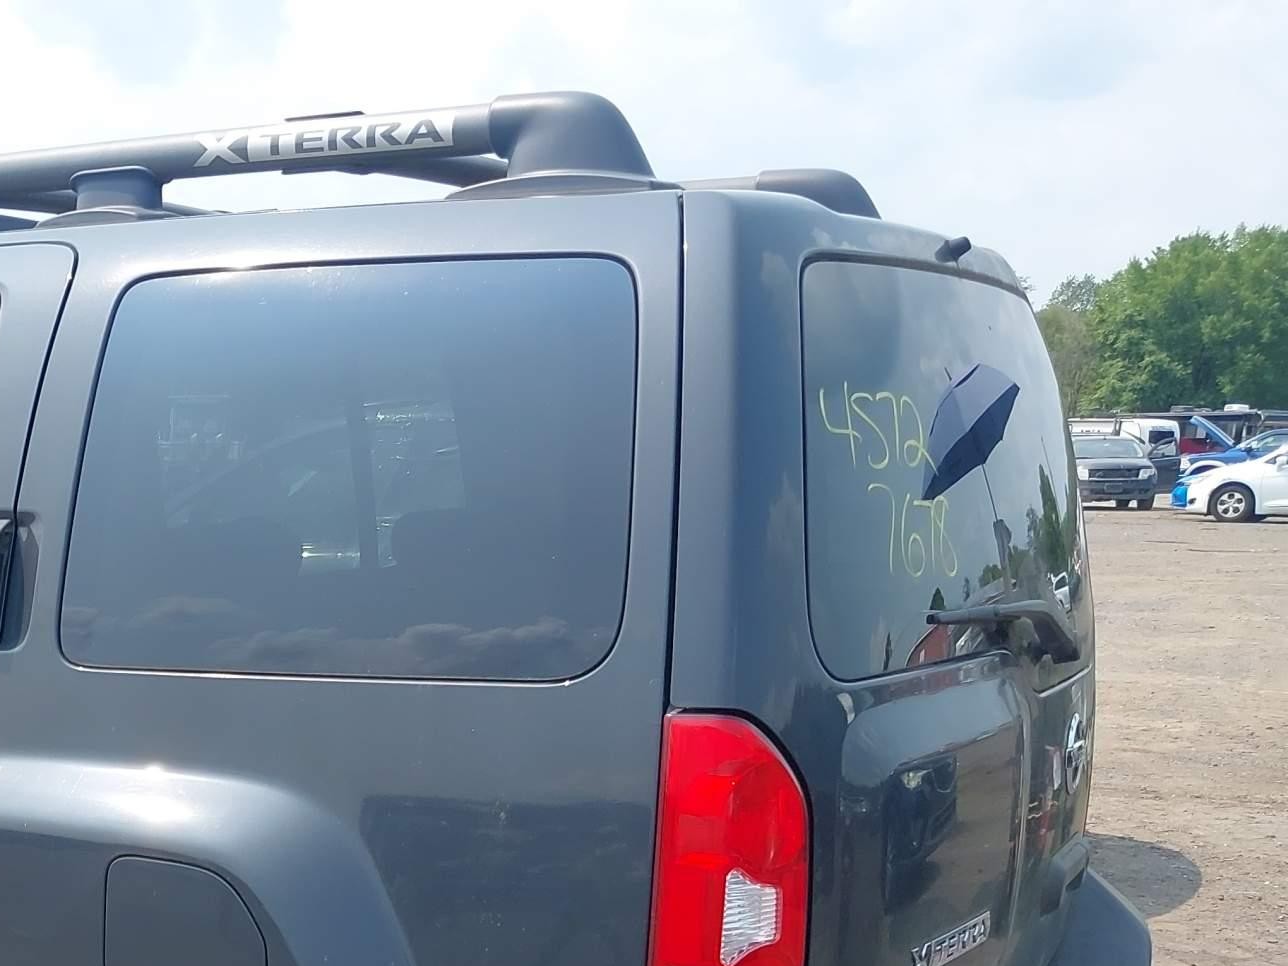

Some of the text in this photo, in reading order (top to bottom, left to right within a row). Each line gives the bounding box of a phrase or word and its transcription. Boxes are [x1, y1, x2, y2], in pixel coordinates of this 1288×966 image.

[194, 119, 446, 167] XTERRA
[819, 381, 938, 475] 4572
[868, 484, 958, 577] 7678
